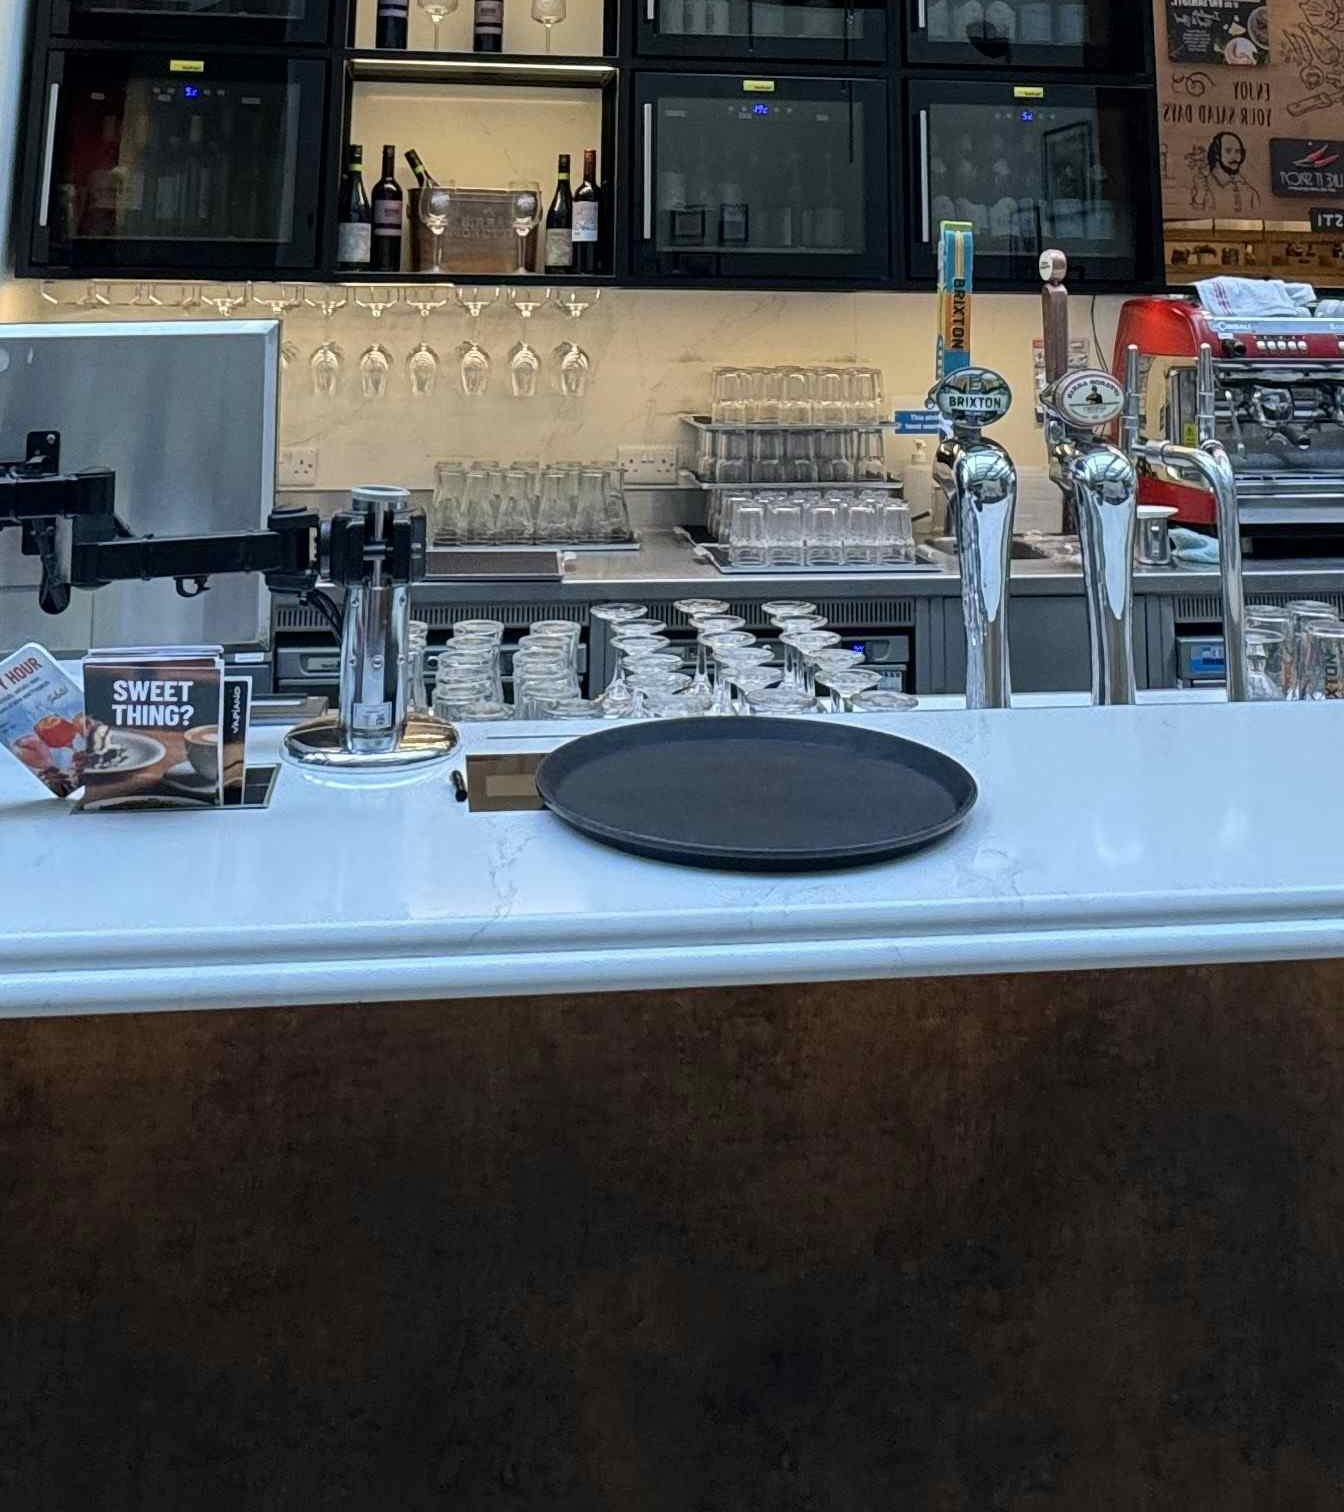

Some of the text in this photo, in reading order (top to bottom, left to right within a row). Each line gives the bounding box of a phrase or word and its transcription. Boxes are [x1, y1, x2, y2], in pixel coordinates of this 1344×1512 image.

[952, 278, 966, 350] BRIXTON
[949, 396, 1002, 409] BRIXTON
[4, 656, 43, 684] HOUR
[112, 679, 194, 703] SWEET
[111, 703, 194, 727] THING?
